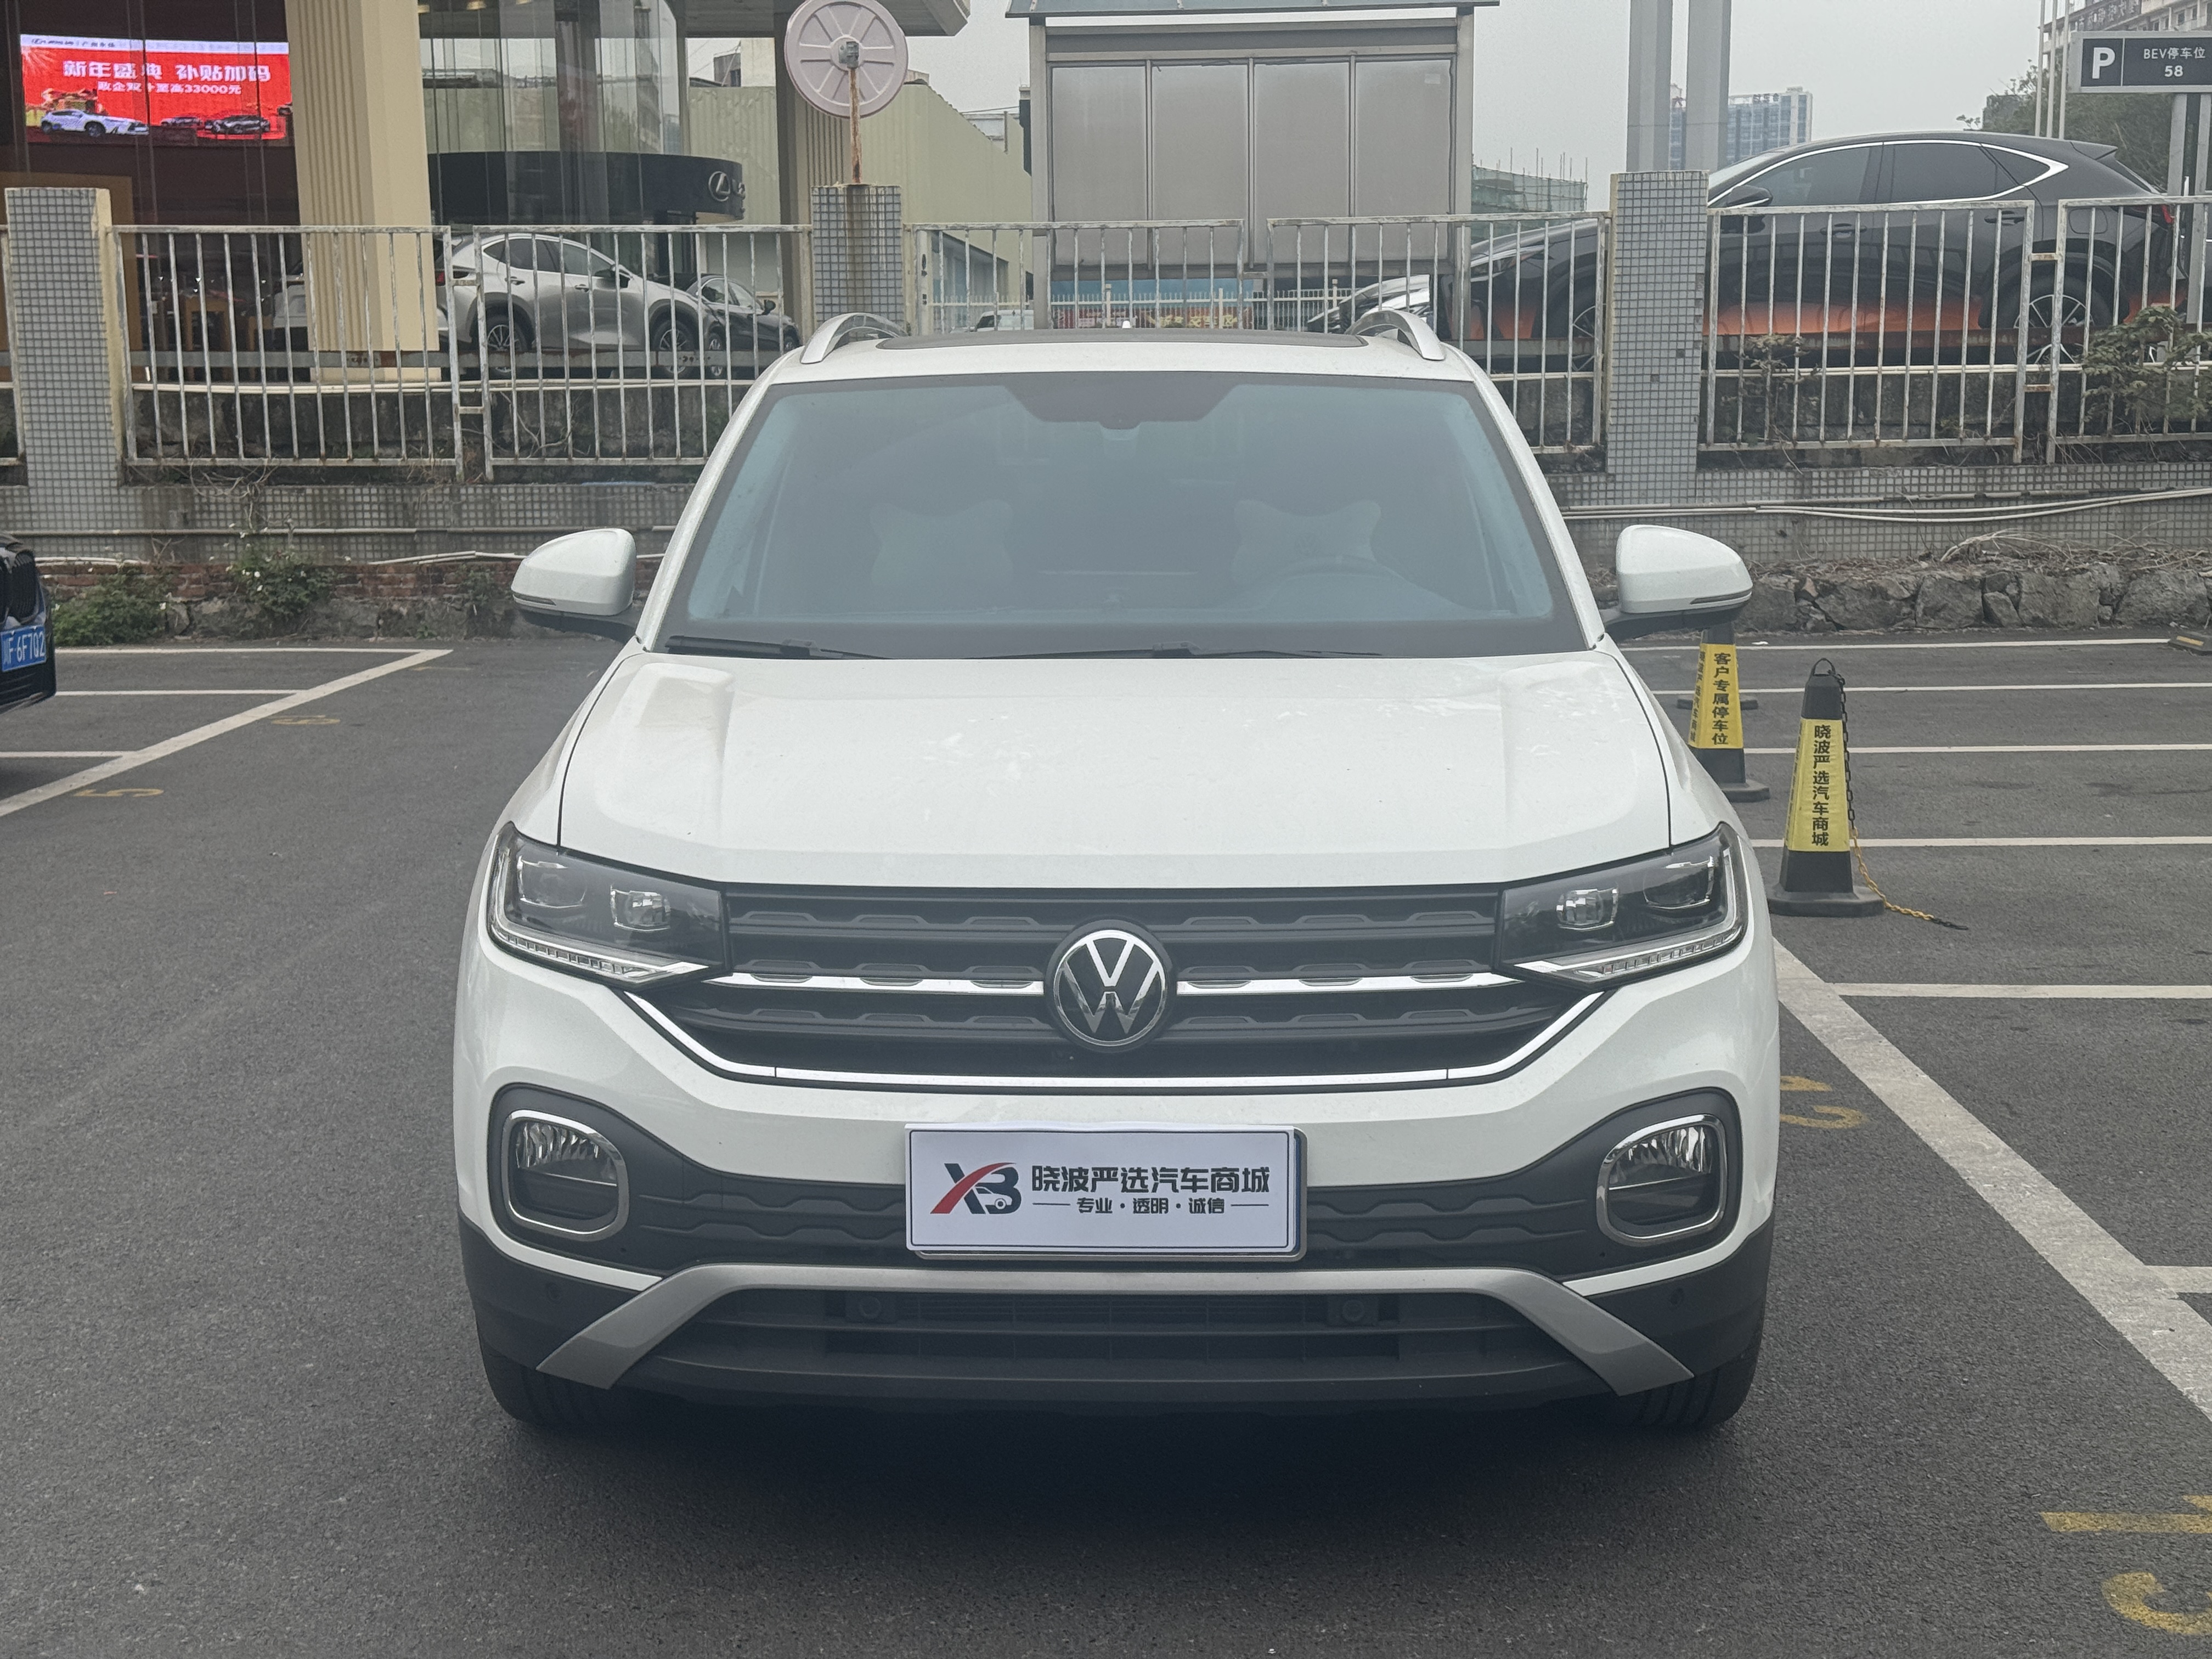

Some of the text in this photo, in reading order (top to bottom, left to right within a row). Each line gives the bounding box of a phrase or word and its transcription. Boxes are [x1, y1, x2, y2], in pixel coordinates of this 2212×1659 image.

[2092, 47, 2115, 79] P
[2143, 47, 2206, 60] BEV停车位
[63, 60, 271, 82] 新年盛典 补贴加码
[2164, 65, 2183, 77] 58
[1711, 652, 1731, 745] 客户专属停车位
[1812, 724, 1832, 847] 晓波严选汽车商城
[1031, 1165, 1270, 1193] 晓波严选汽车商城
